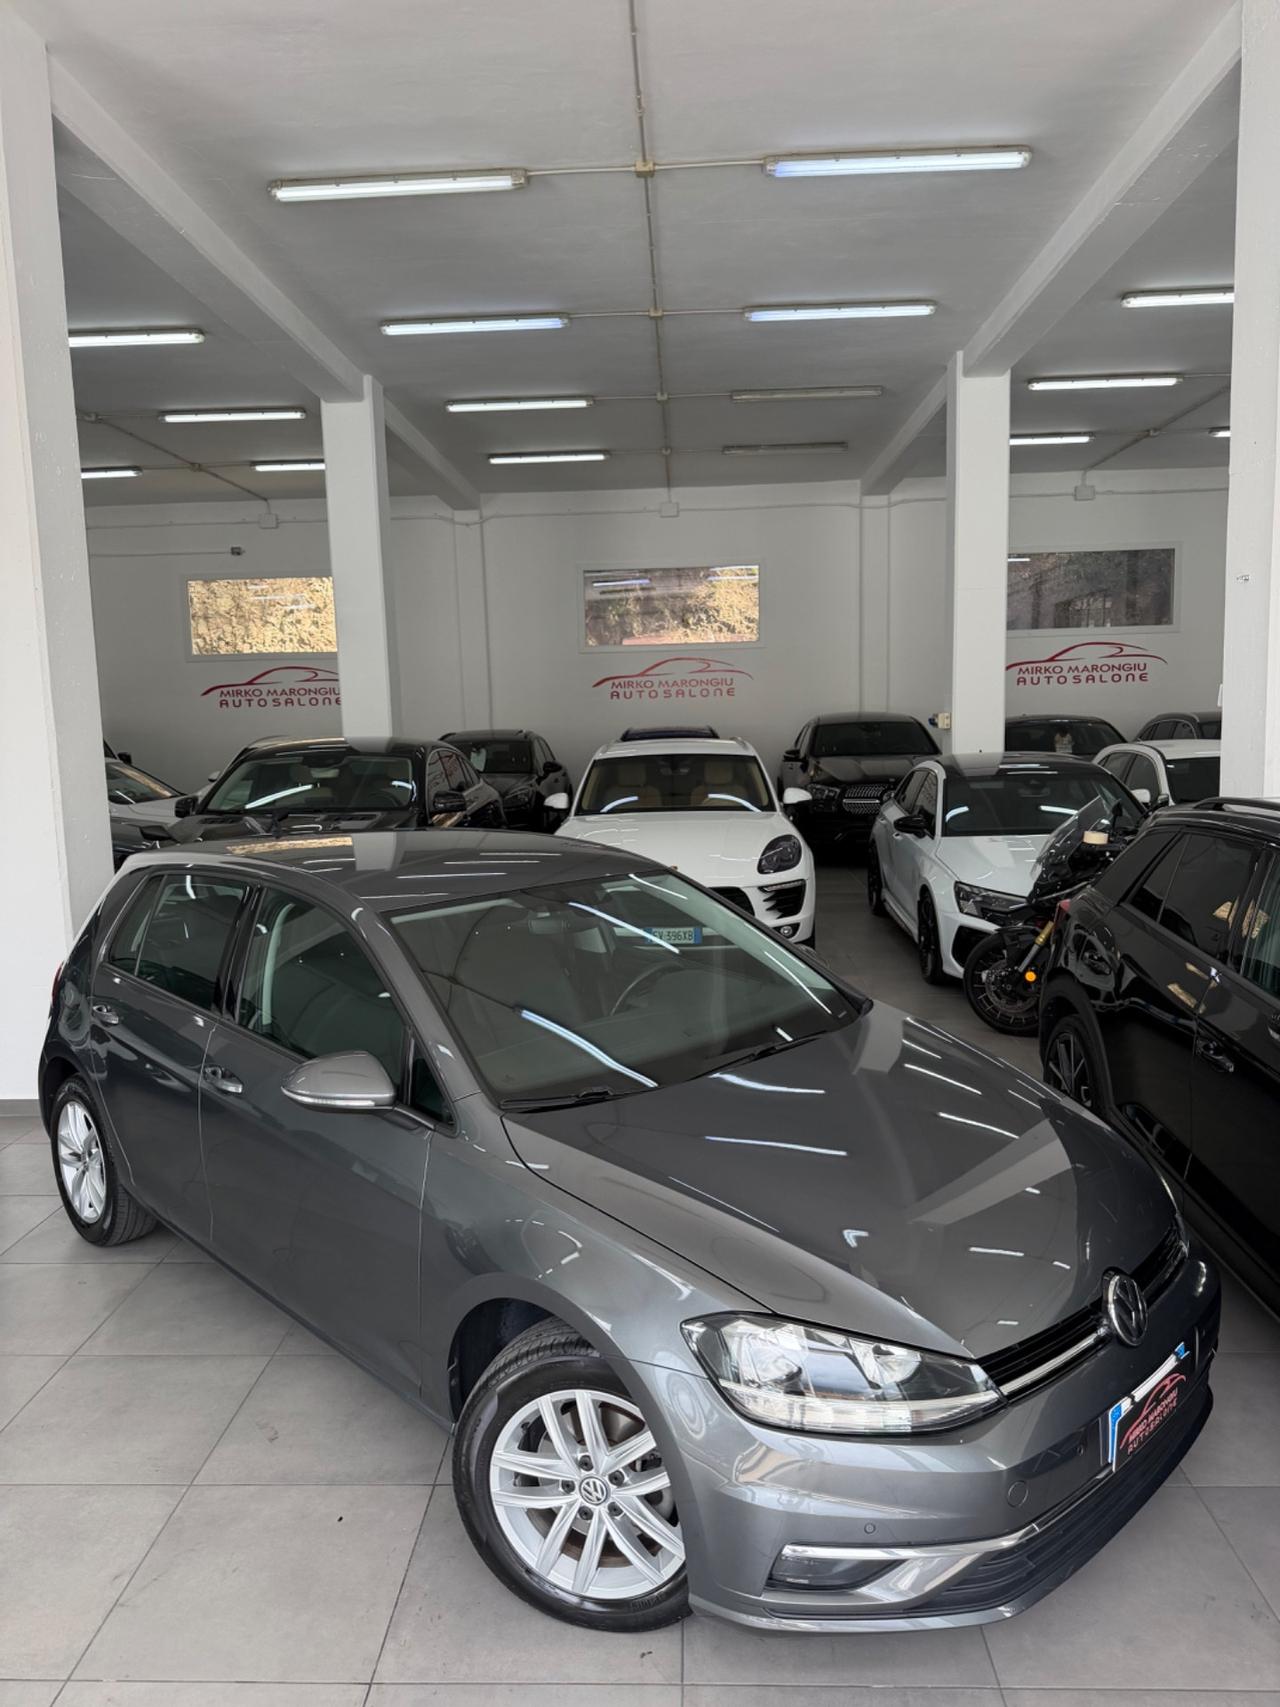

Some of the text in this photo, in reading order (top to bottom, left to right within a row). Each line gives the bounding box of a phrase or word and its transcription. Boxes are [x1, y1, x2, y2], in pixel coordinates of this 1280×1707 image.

[1017, 663, 1147, 675] MIRKO MARONGIU
[611, 678, 734, 689] MIRKO MARONGIU
[1016, 673, 1149, 686] AUTOSALONE
[220, 687, 340, 698] MIRKO MARONGIU
[610, 687, 736, 700] AUTOSALONE
